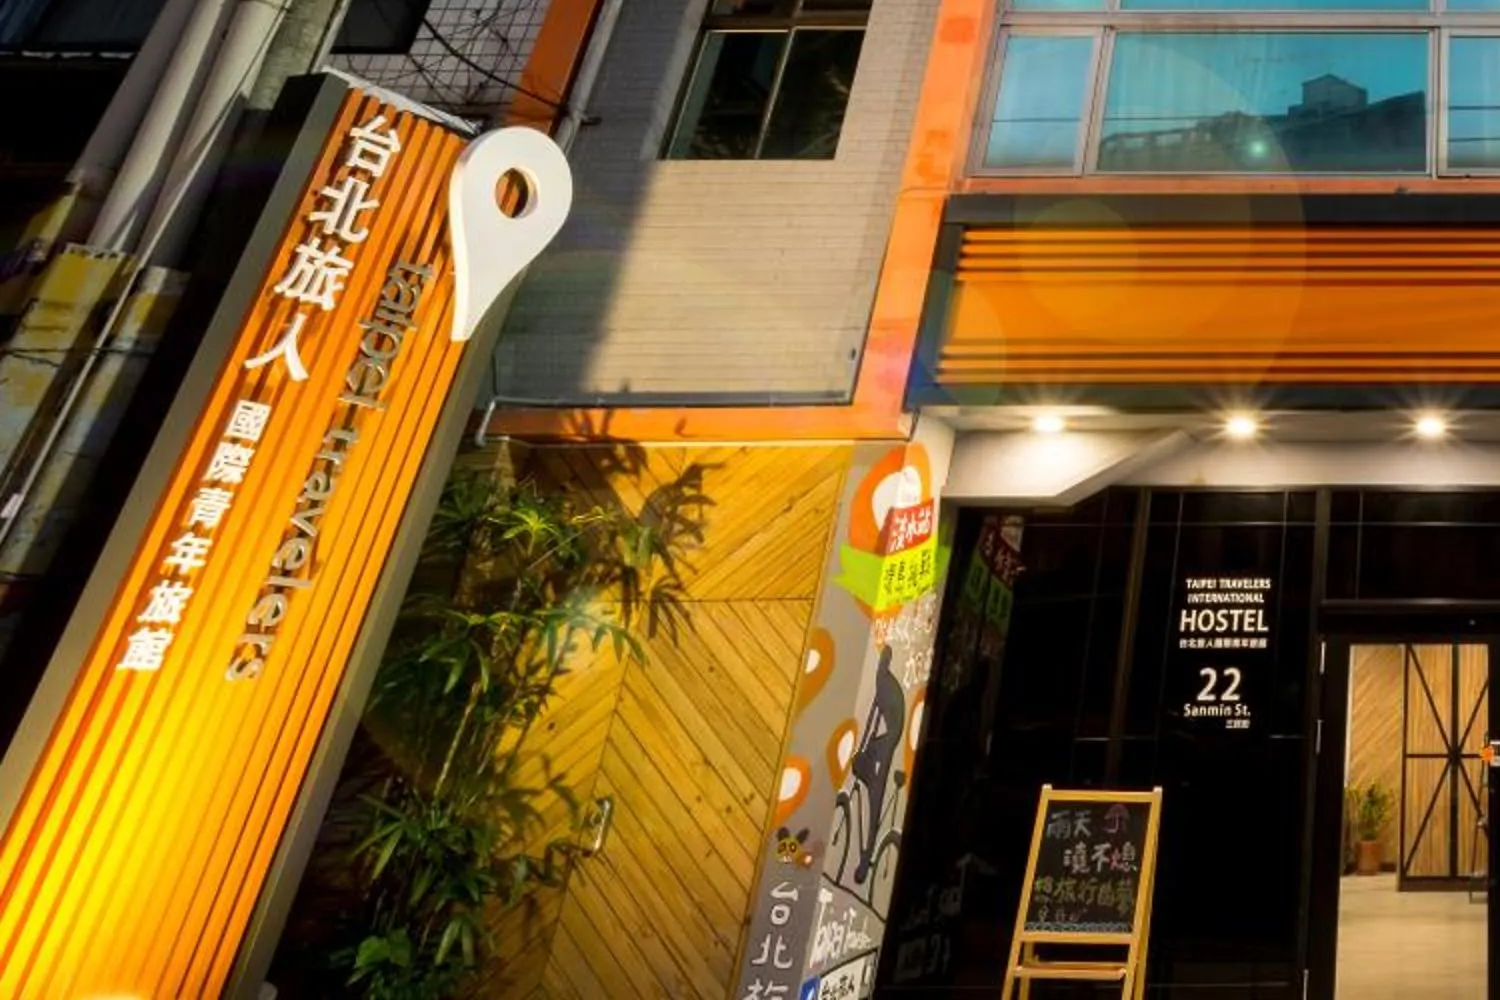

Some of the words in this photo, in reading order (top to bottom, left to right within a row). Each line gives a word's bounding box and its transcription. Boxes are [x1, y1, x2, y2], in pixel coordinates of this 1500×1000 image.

[245, 115, 401, 383] 台北旅人
[115, 398, 272, 673] 國際青年旅館
[1186, 577, 1217, 590] TAIPEI
[1218, 577, 1272, 590] TRAVELERS
[1187, 592, 1265, 604] INTERNATIONAL
[1179, 608, 1270, 633] HOSTEL
[1197, 666, 1242, 702] 22
[1183, 703, 1232, 718] Sanmin
[1234, 703, 1252, 717] St.
